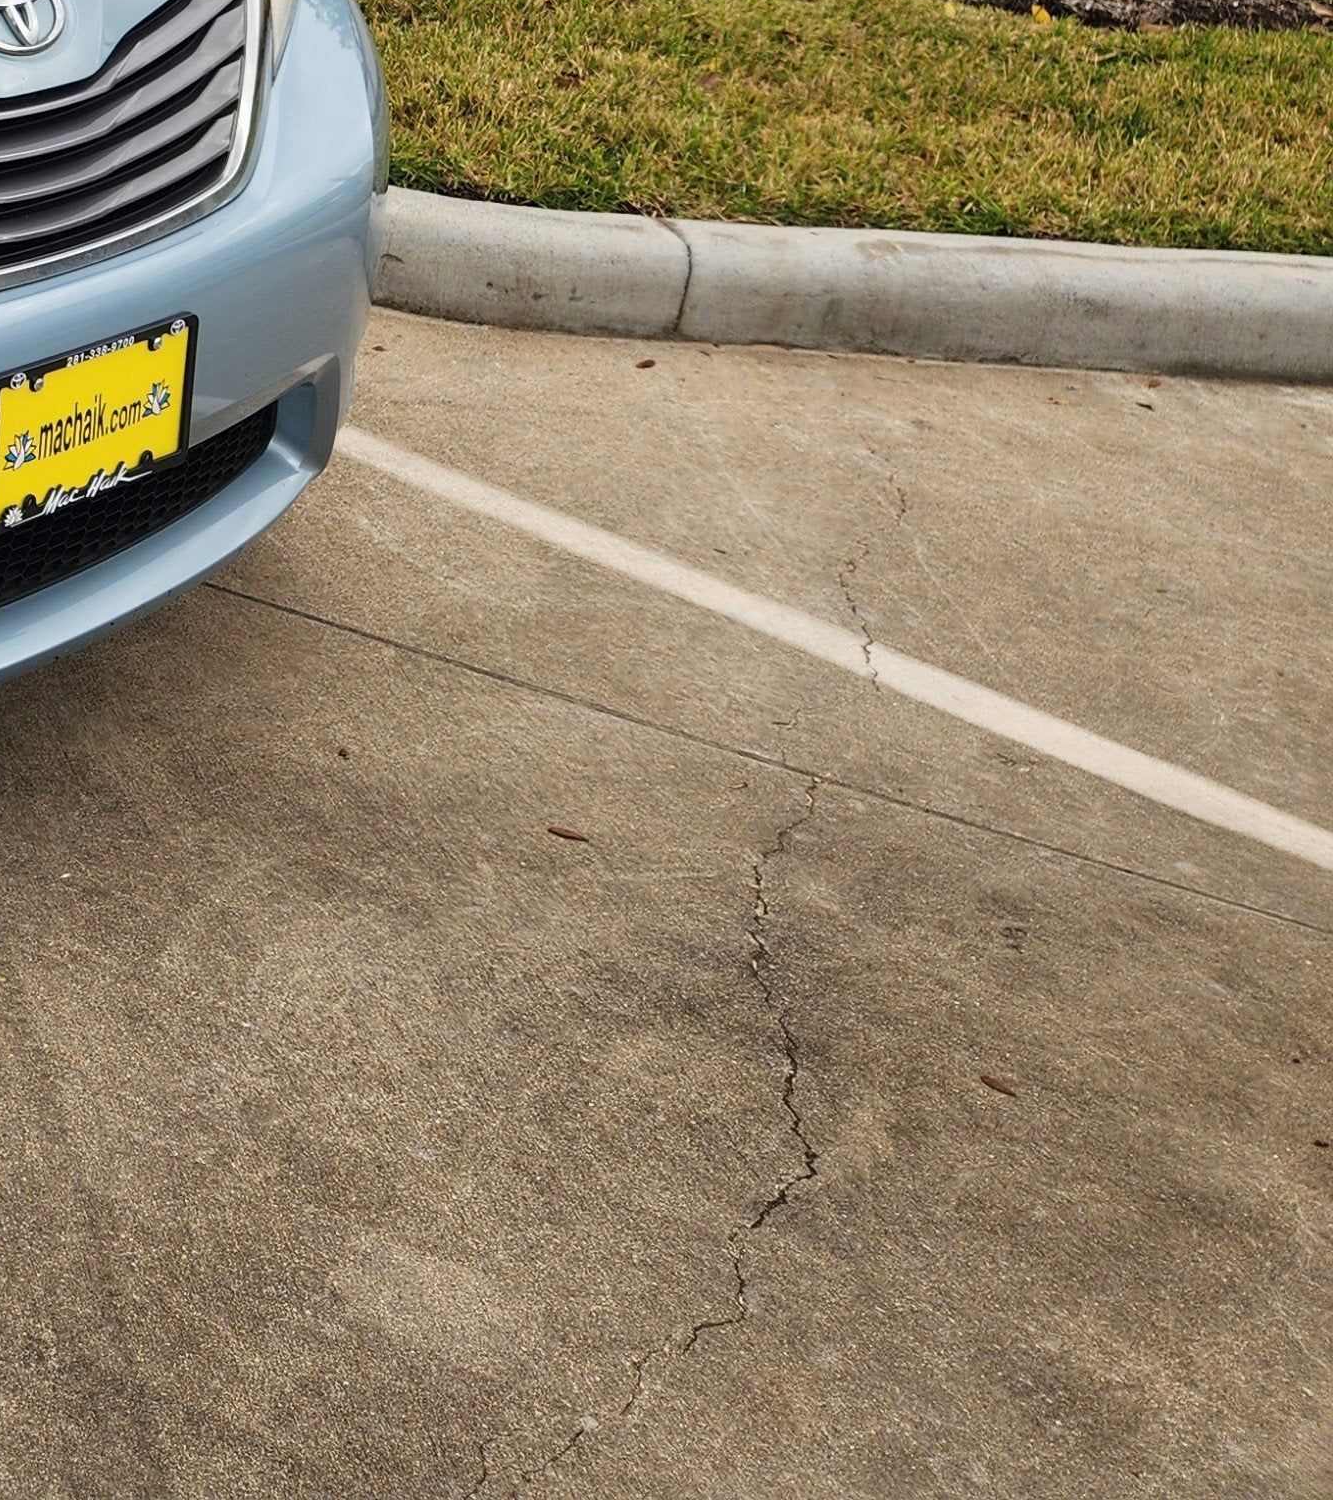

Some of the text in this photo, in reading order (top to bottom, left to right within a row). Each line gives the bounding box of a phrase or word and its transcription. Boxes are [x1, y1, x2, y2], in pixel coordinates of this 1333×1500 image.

[66, 336, 135, 367] 281-338-9700
[37, 393, 142, 461] machaik.com
[41, 462, 134, 515] Mac Haik
